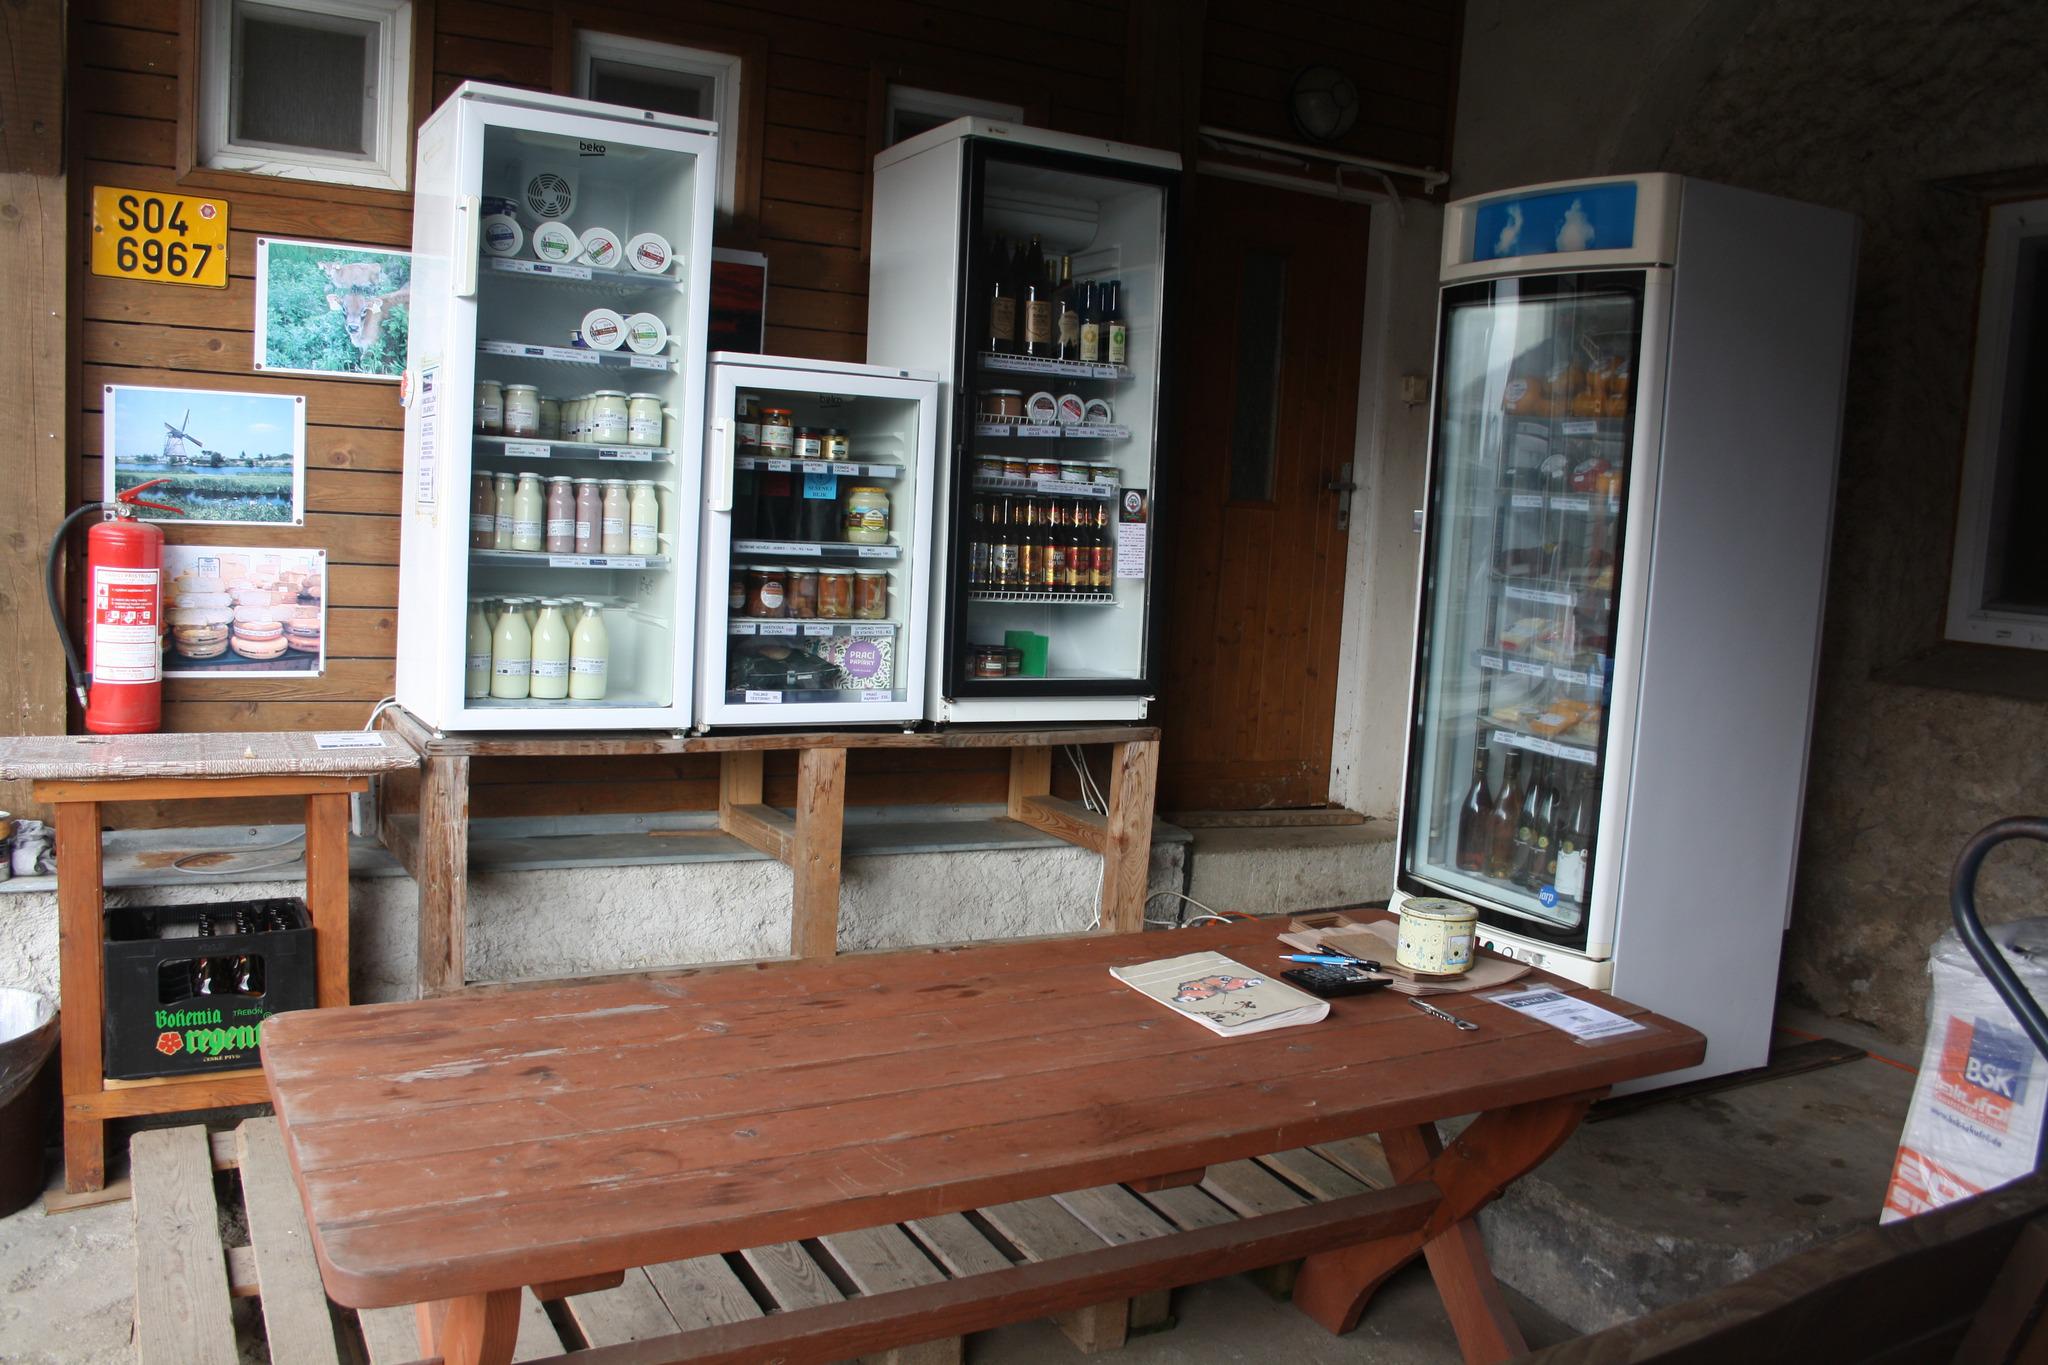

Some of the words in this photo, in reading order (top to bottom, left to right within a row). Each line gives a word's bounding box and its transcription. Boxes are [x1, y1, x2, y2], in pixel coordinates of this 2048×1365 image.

[579, 140, 606, 153] beko
[117, 236, 212, 279] 6967
[849, 651, 875, 660] PRACÍ
[849, 659, 875, 667] PAPÍRKY
[1539, 888, 1554, 904] iarp
[155, 1008, 223, 1029] Bohemia
[1965, 1056, 2016, 1098] BSK
